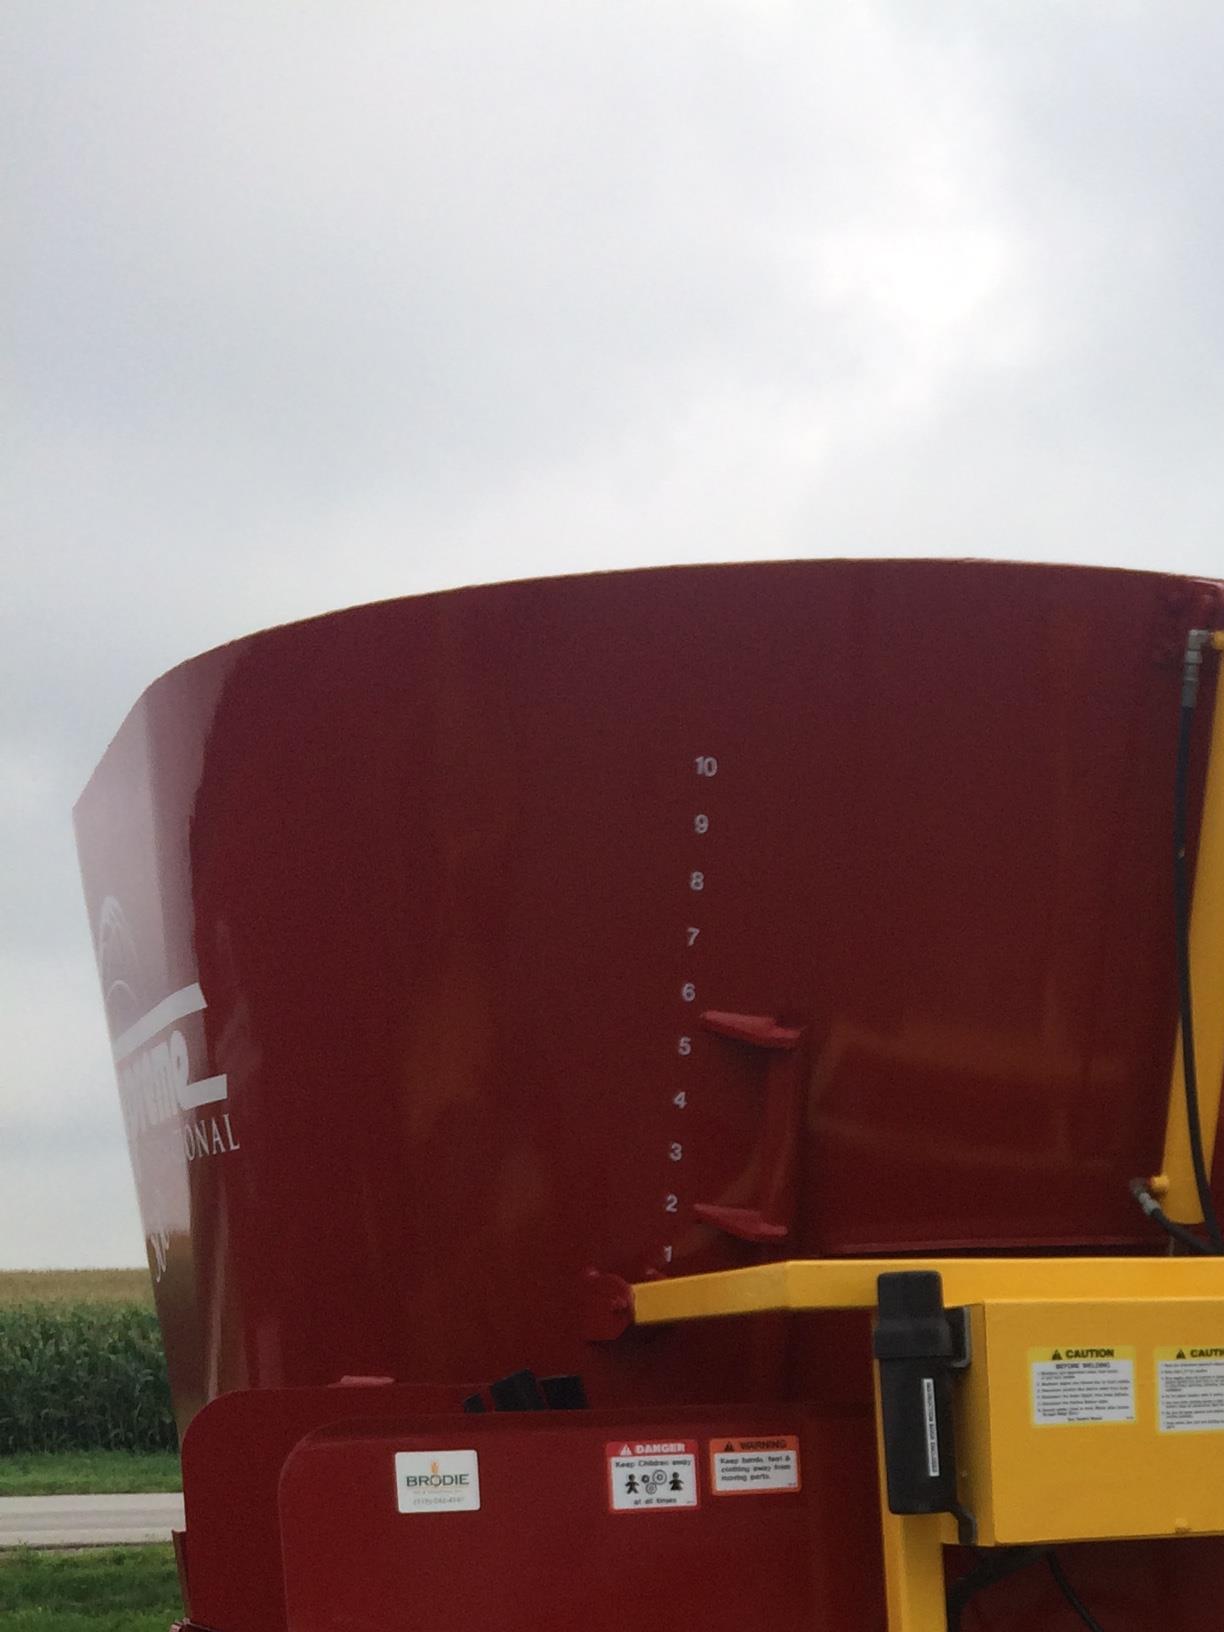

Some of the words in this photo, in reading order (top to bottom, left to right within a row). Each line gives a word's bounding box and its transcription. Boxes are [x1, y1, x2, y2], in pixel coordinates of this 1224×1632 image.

[695, 756, 718, 777] 10
[694, 814, 709, 834] 9
[690, 871, 704, 891] 8
[687, 927, 700, 946] 7
[682, 982, 696, 1002] 6
[678, 1036, 691, 1056] 5
[673, 1091, 687, 1109] 4
[670, 1142, 683, 1161] 3
[665, 1194, 678, 1213] 2
[663, 1245, 673, 1263] 1
[1065, 1348, 1115, 1359] CAUTION
[635, 1442, 686, 1454] DANGER
[406, 1473, 470, 1488] BRODIE
